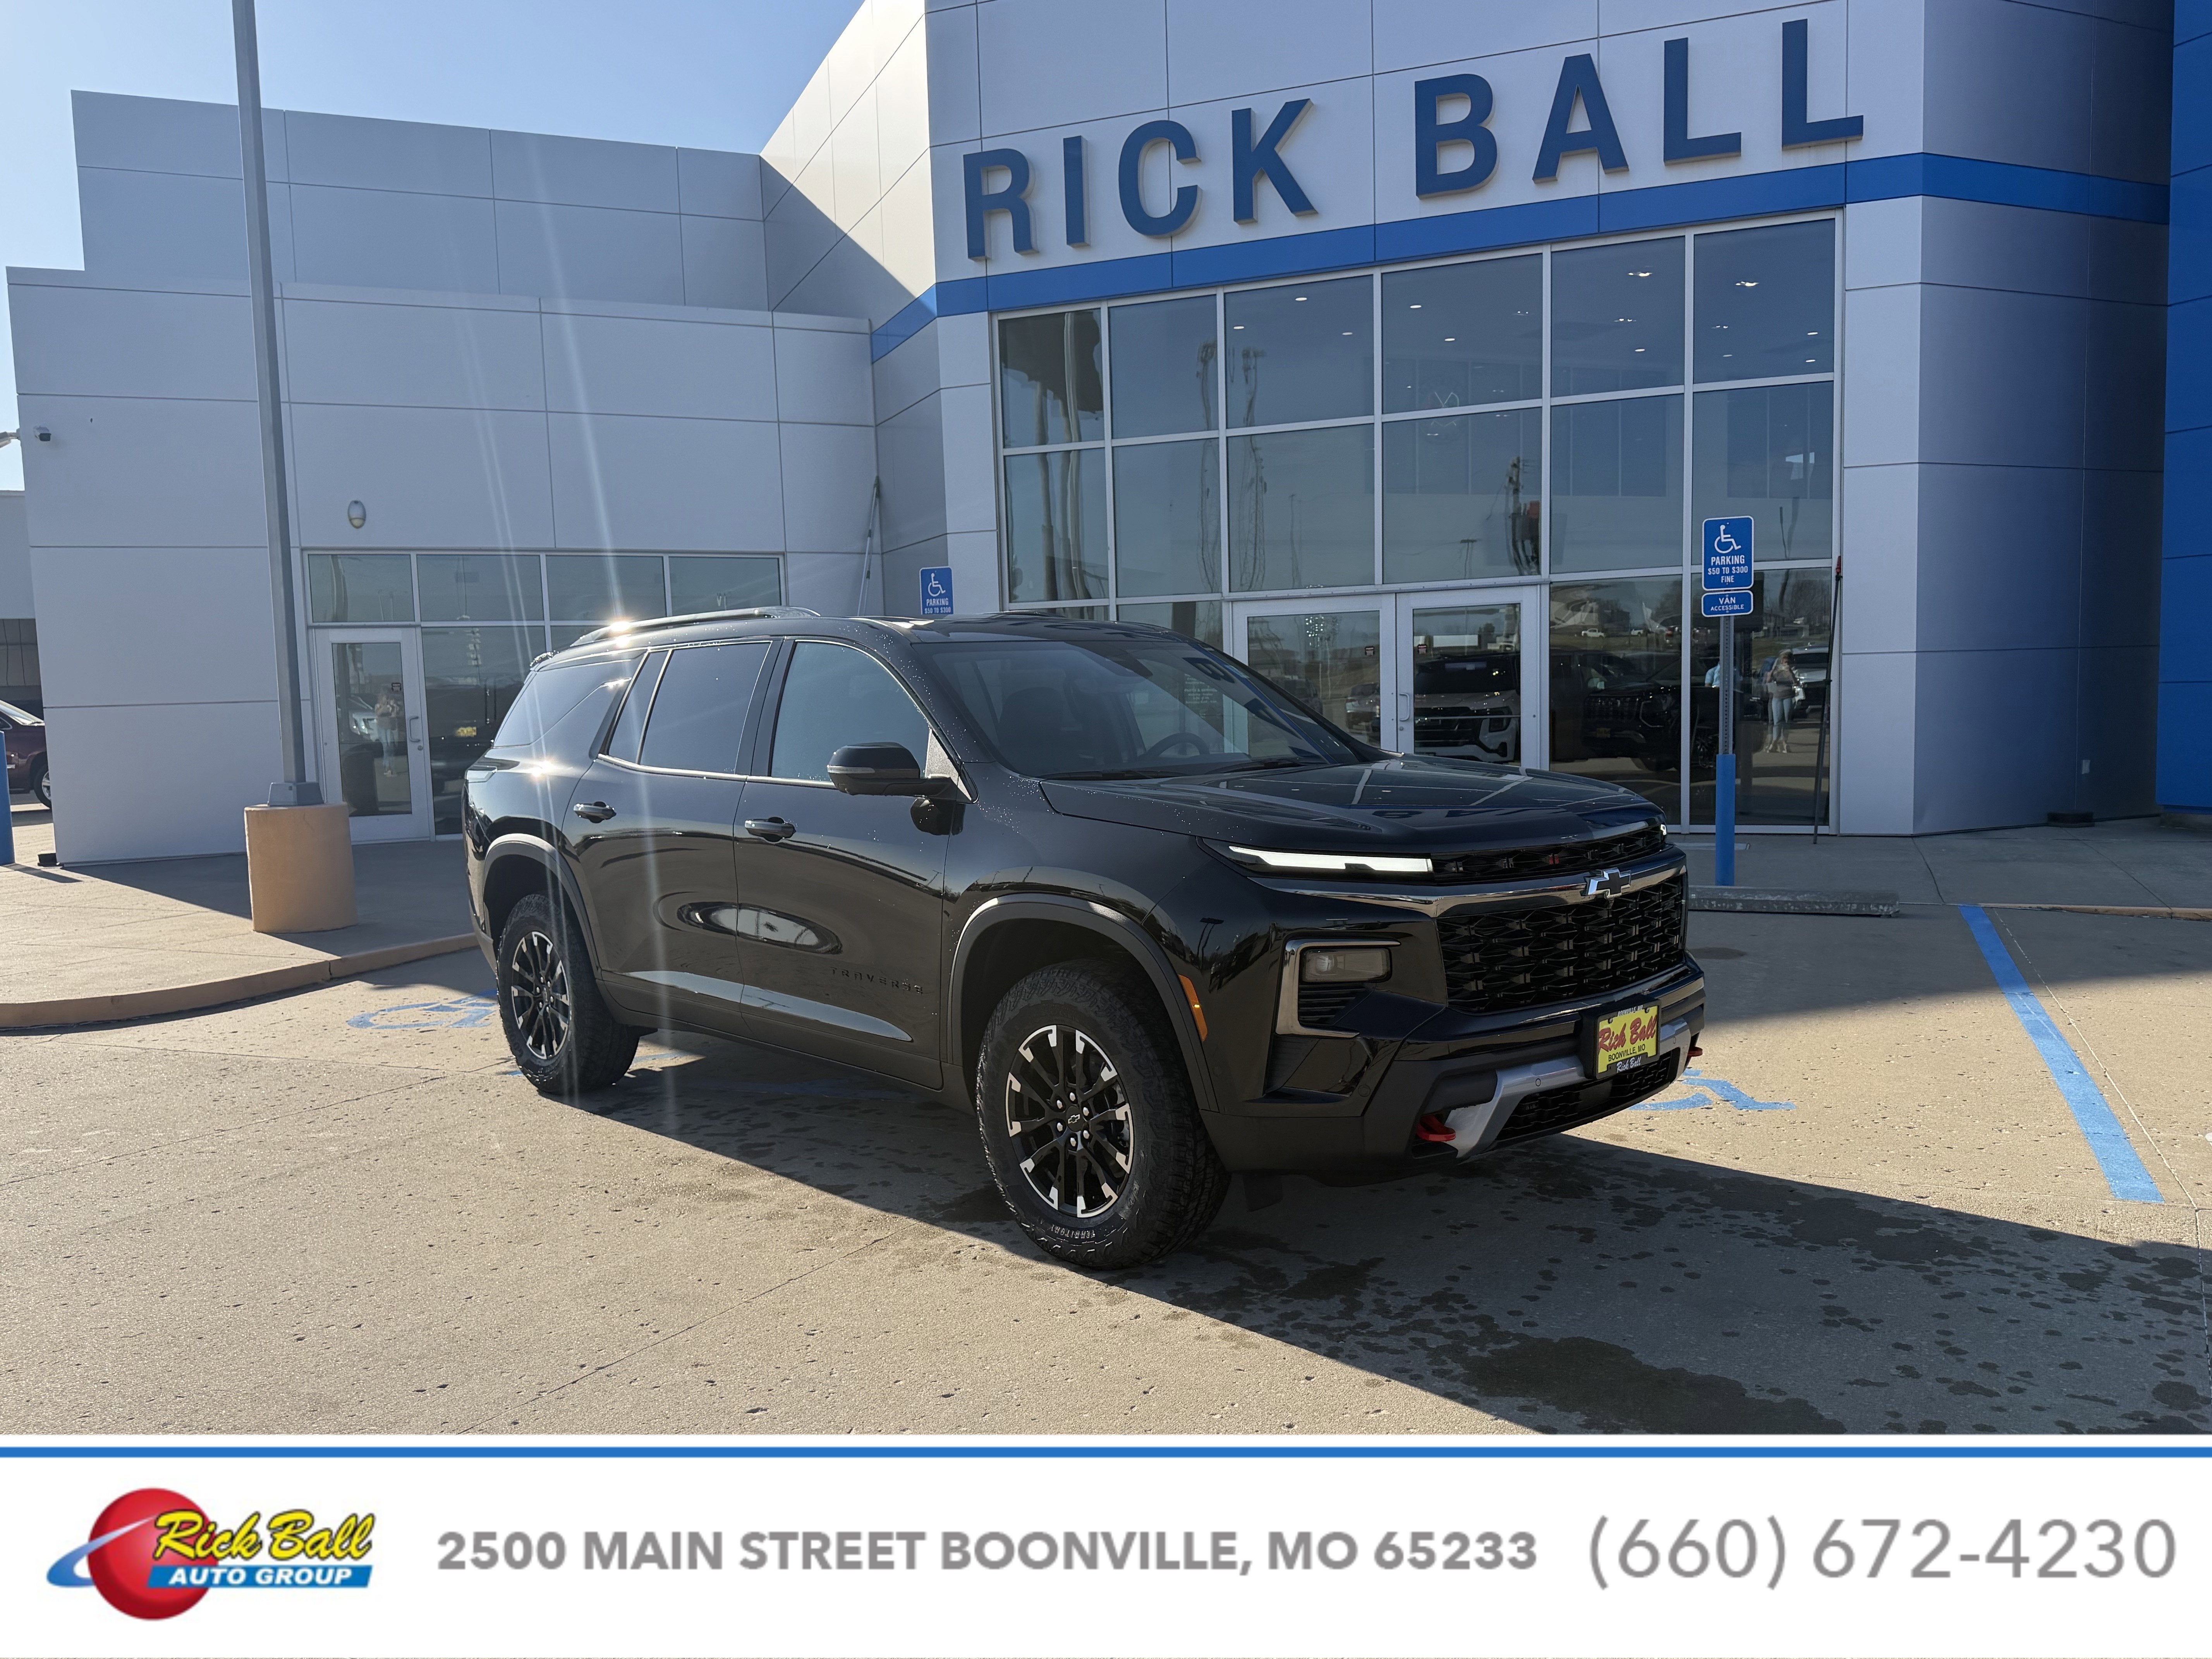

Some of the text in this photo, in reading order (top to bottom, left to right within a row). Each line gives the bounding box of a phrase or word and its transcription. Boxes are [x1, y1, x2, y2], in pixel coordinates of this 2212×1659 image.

[963, 18, 1863, 261] RICK BALL
[1711, 555, 1745, 565] PARKING
[1708, 567, 1720, 575] $50
[926, 598, 949, 606] PARKING
[831, 967, 923, 994] TRAVERSE
[1599, 1015, 1658, 1052] Rick Ball
[1608, 1044, 1645, 1062] BOONVILLE, MO
[1616, 1056, 1642, 1073] Rick Ball
